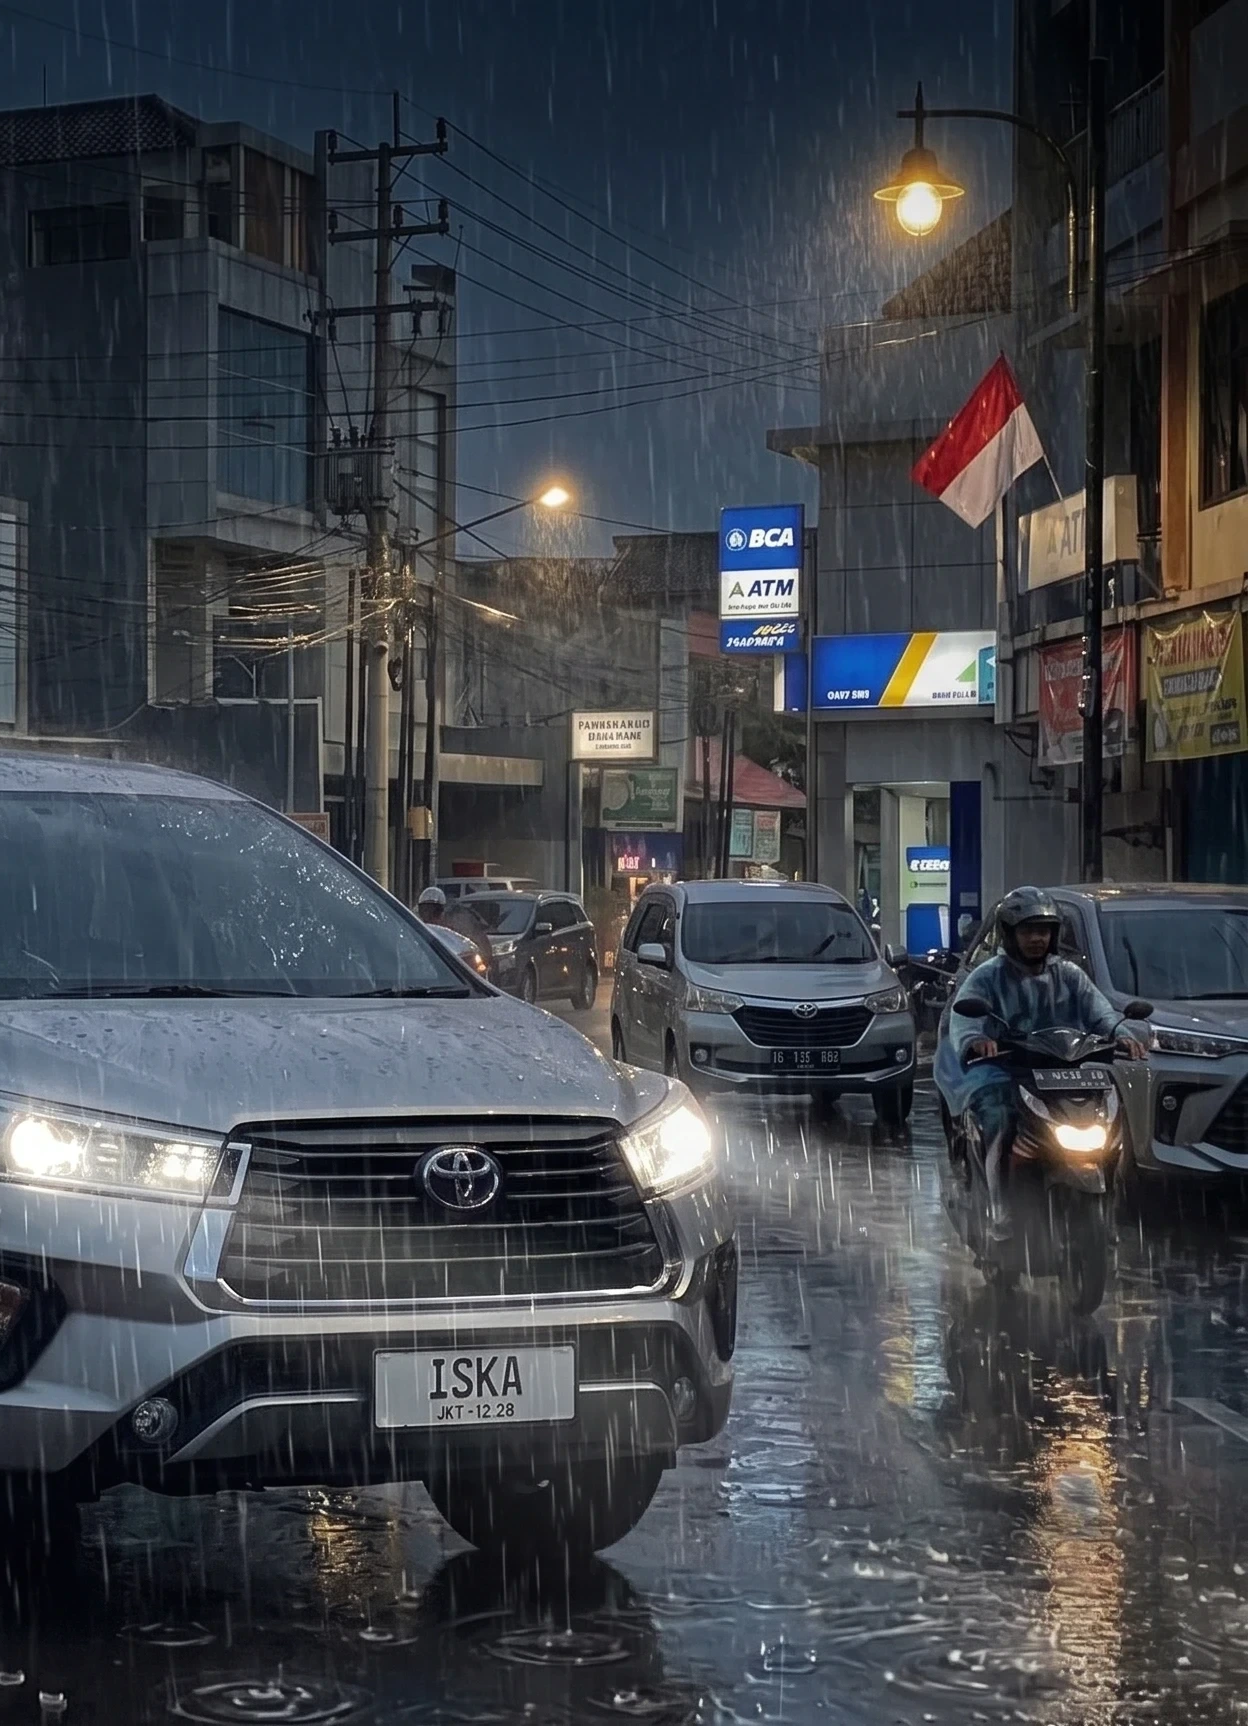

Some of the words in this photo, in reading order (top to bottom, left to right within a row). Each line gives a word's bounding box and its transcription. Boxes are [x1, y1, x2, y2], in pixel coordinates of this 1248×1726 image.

[748, 527, 794, 548] BCA
[1060, 508, 1086, 559] AT
[747, 578, 794, 597] ATM
[429, 1355, 523, 1400] ISKA
[437, 1404, 464, 1420] JKT
